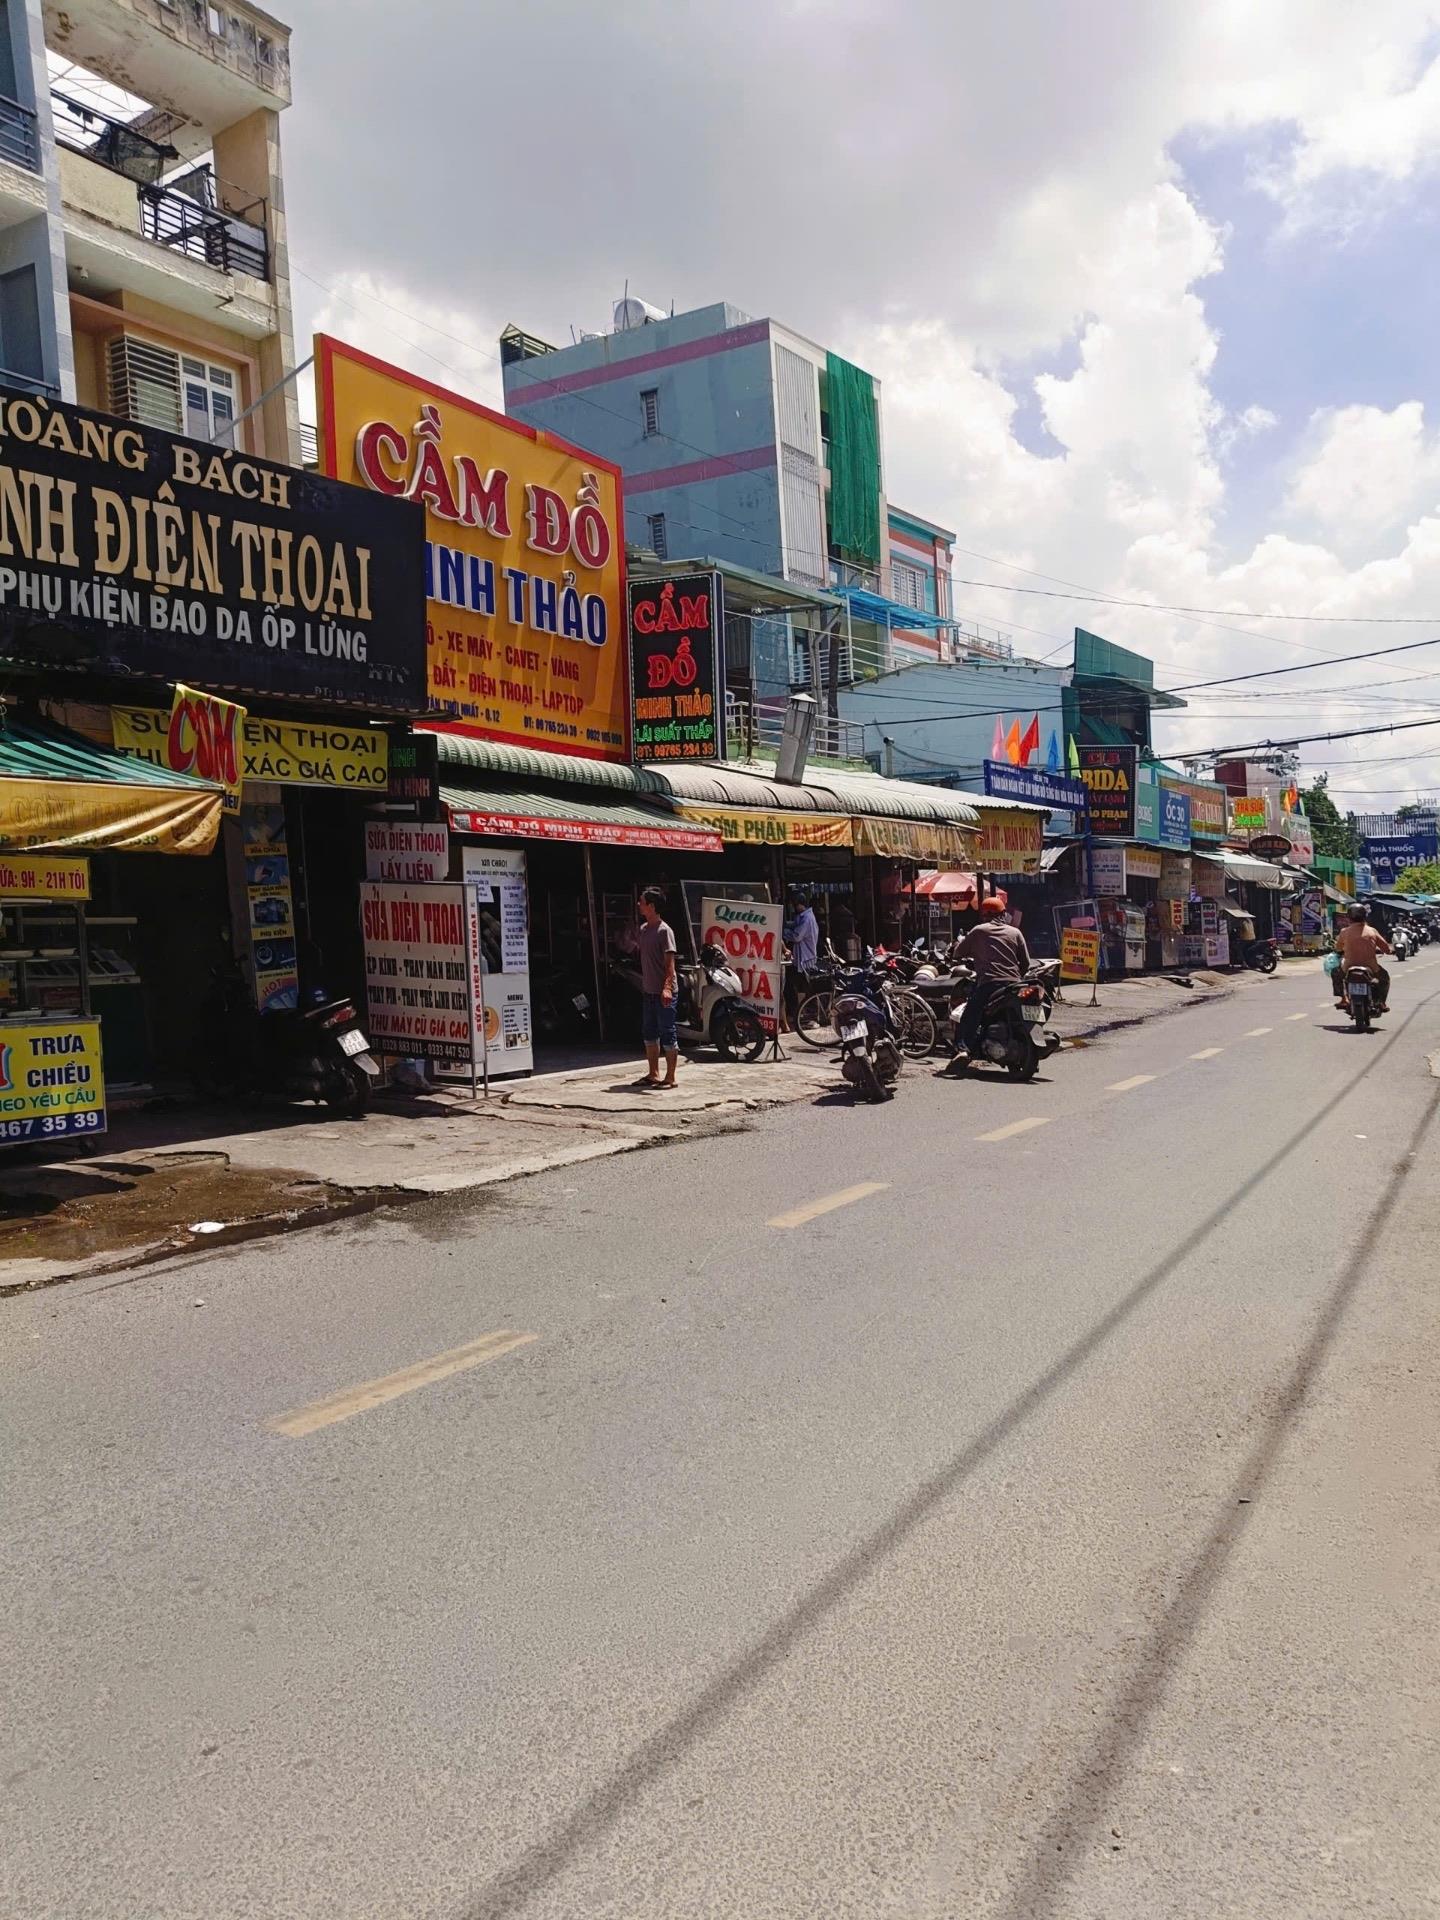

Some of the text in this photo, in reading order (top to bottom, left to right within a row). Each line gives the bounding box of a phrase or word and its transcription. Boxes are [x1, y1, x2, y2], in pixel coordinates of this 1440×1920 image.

[171, 444, 292, 510] BÁCH
[356, 404, 611, 570] CẦM ĐỒ
[92, 481, 224, 596] ĐIỆN
[230, 520, 373, 623] THOẠI
[0, 567, 62, 619] PHỤ
[150, 594, 207, 636] BAO
[216, 606, 253, 645] DA
[262, 603, 297, 650] ỐP
[502, 566, 608, 647] THẢO
[634, 582, 709, 634] CẦM
[446, 630, 463, 651] XE
[467, 634, 493, 661] MÁY
[505, 645, 540, 672] CAVET
[551, 655, 580, 681] VÀNG
[648, 636, 696, 688] ĐỒ
[433, 657, 457, 688] ĐẤT
[469, 671, 496, 701] ĐIỆN
[500, 679, 533, 708] THOẠI
[542, 689, 583, 715] LAPTOP
[636, 687, 712, 720] MINH THẢO
[291, 728, 377, 757] THOẠI
[298, 757, 335, 782] GIÁ
[342, 764, 387, 784] CAO
[1081, 769, 1129, 791] BIDA
[389, 828, 412, 856] ĐIỆN
[415, 832, 445, 857] THOẠI
[544, 823, 582, 835] MINH
[1388, 843, 1415, 853] THUỐC
[21, 871, 35, 888] 9H
[47, 871, 66, 890] 21H
[69, 864, 85, 890] TỐI
[364, 885, 389, 941] SỬA
[391, 891, 420, 952] ĐIỆN
[423, 903, 463, 956] THOẠI
[715, 904, 767, 926] Quán
[705, 924, 775, 961] CƠM
[404, 958, 424, 979] THAY
[427, 956, 443, 980] MÀN
[402, 988, 419, 1007] THAY
[434, 990, 451, 1010] LINH
[370, 1011, 469, 1040] THU MÁY CŨ GIÁ CAO
[29, 1034, 85, 1056] TRƯA
[458, 1046, 470, 1059] 520
[27, 1061, 91, 1089] CHIỀU
[29, 1091, 61, 1109] YÊU
[65, 1087, 96, 1105] CẦU
[0, 1111, 98, 1138] 467 35 39
